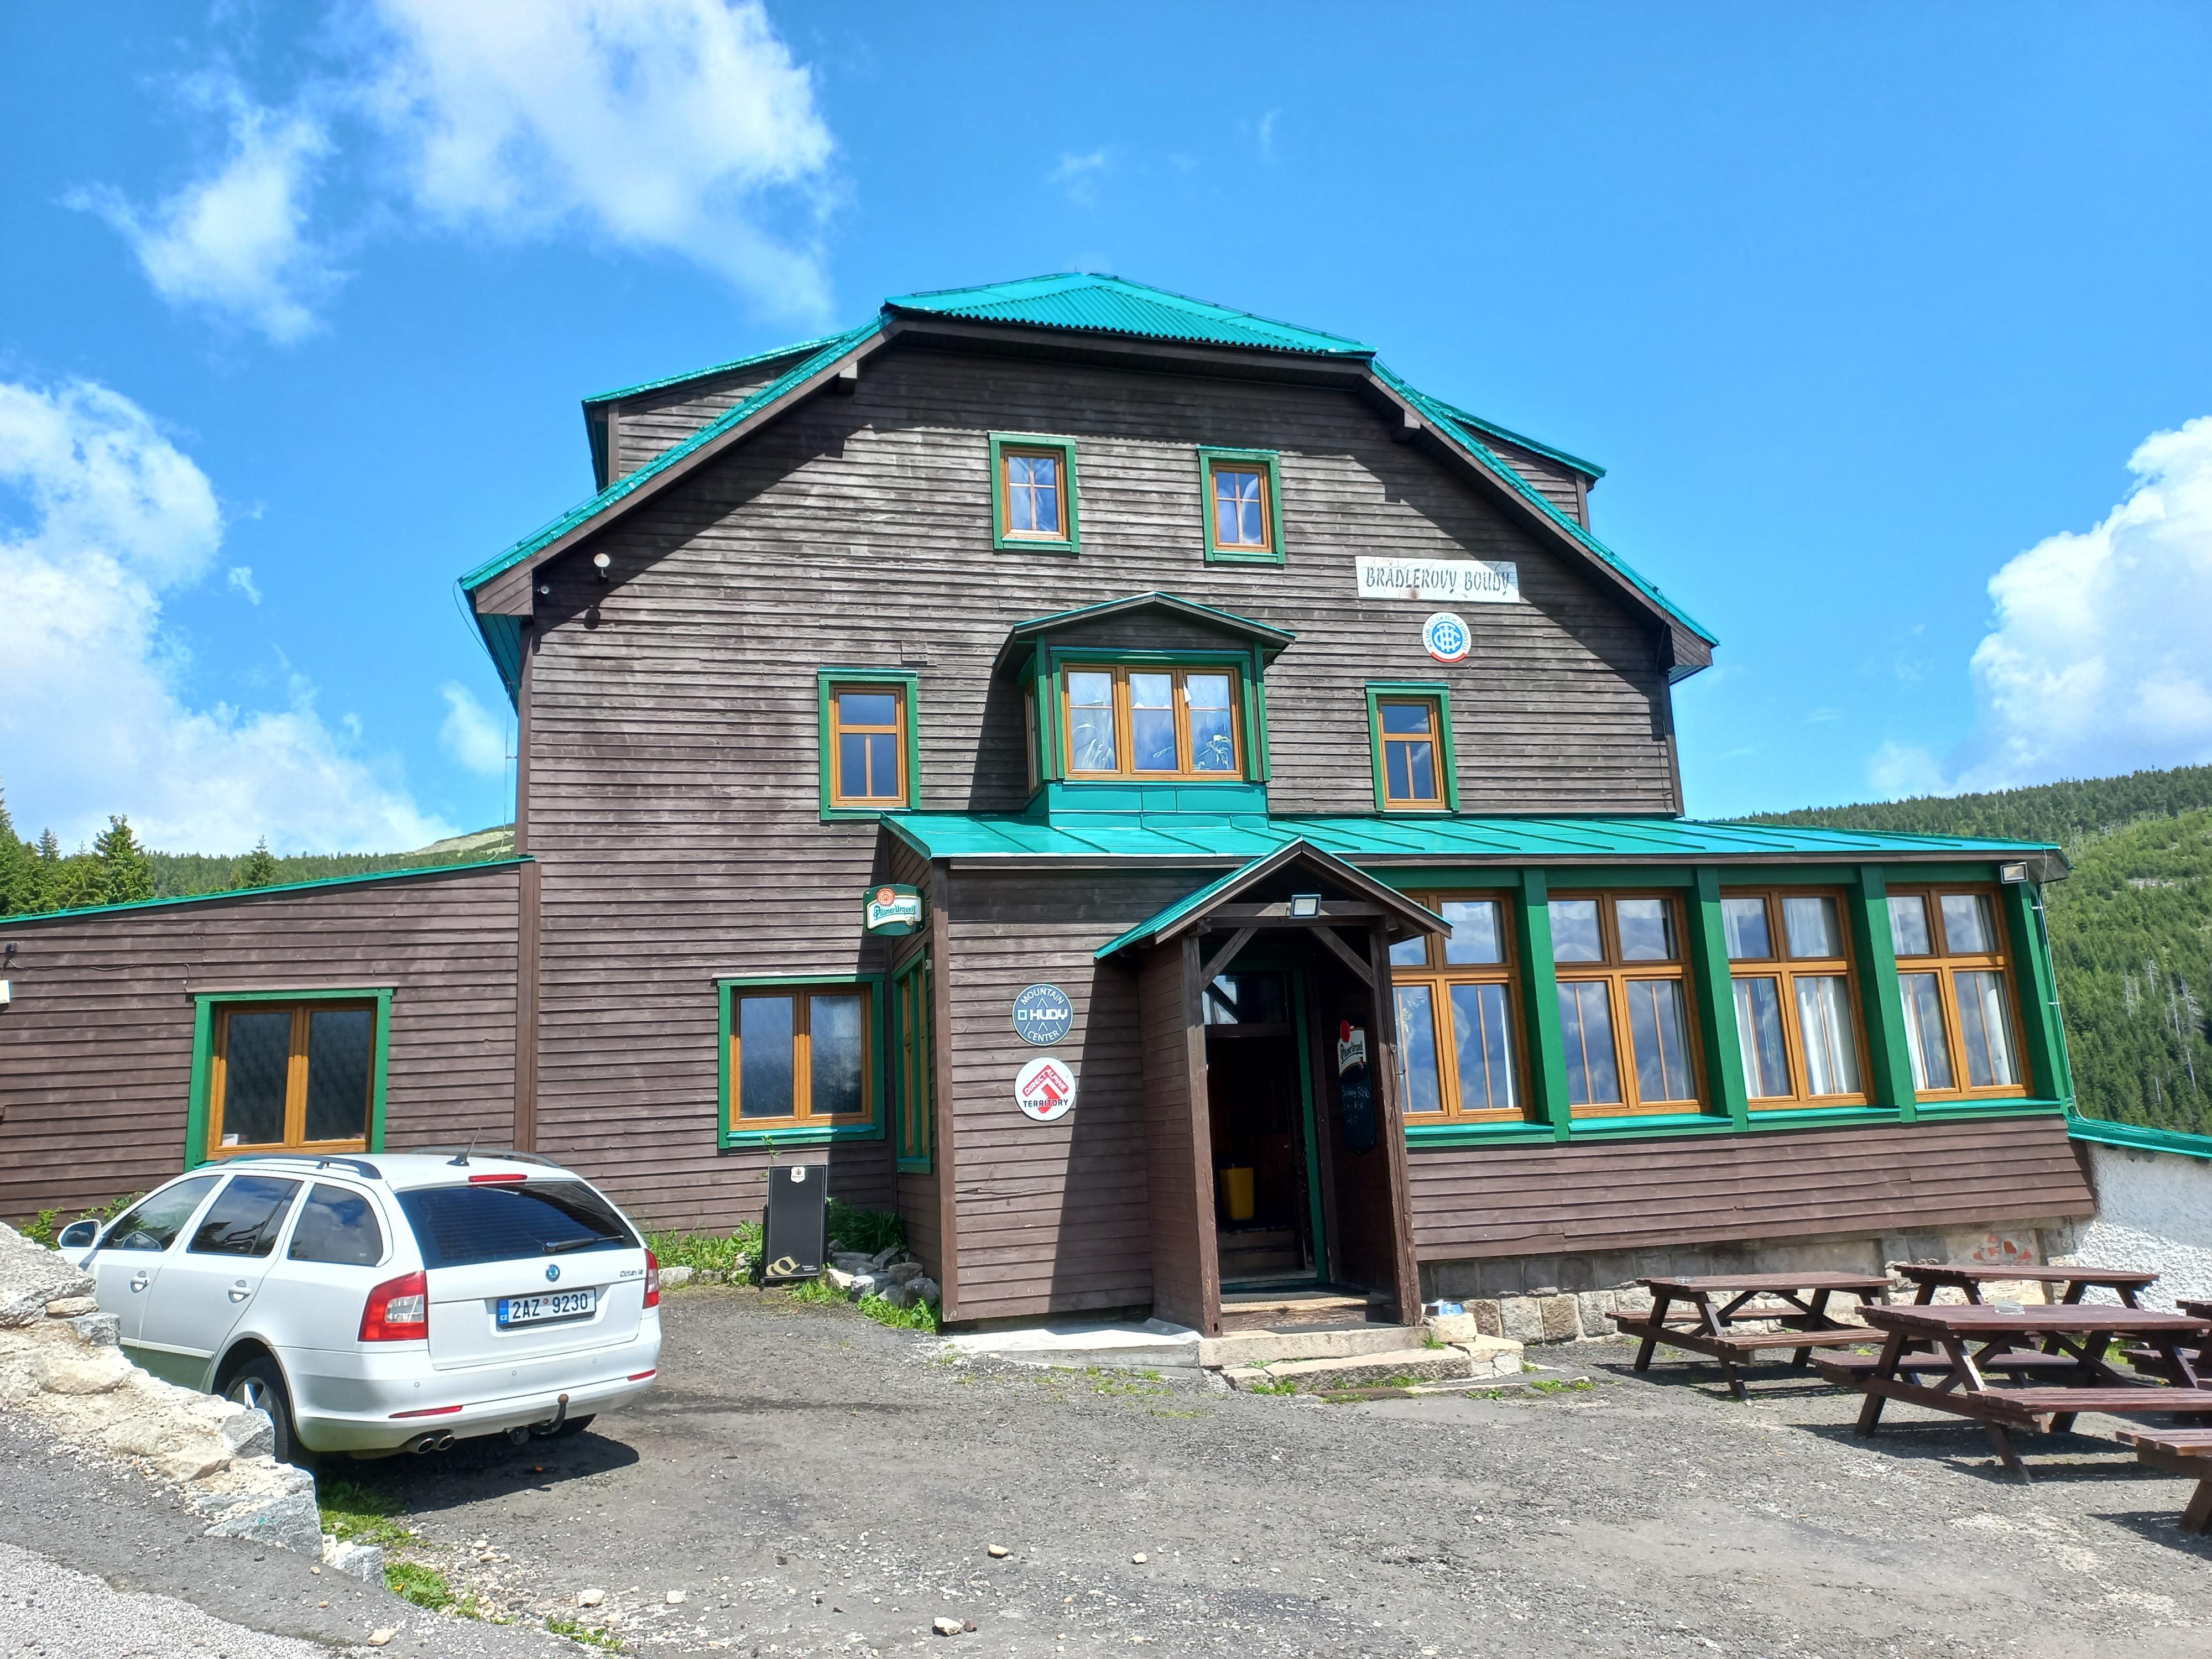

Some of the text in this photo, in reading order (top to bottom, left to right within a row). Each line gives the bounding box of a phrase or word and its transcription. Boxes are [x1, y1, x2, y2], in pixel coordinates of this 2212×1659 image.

[1465, 570, 1509, 596] BOUDY
[874, 905, 915, 920] Pilsner Urquell
[1020, 988, 1065, 1005] MOUNTAIN
[1030, 1009, 1068, 1020] HUDY
[1027, 1030, 1060, 1042] CENTER
[1024, 1068, 1067, 1095] DIRECT ALPINE
[512, 1293, 587, 1319] 2AZ 9230
